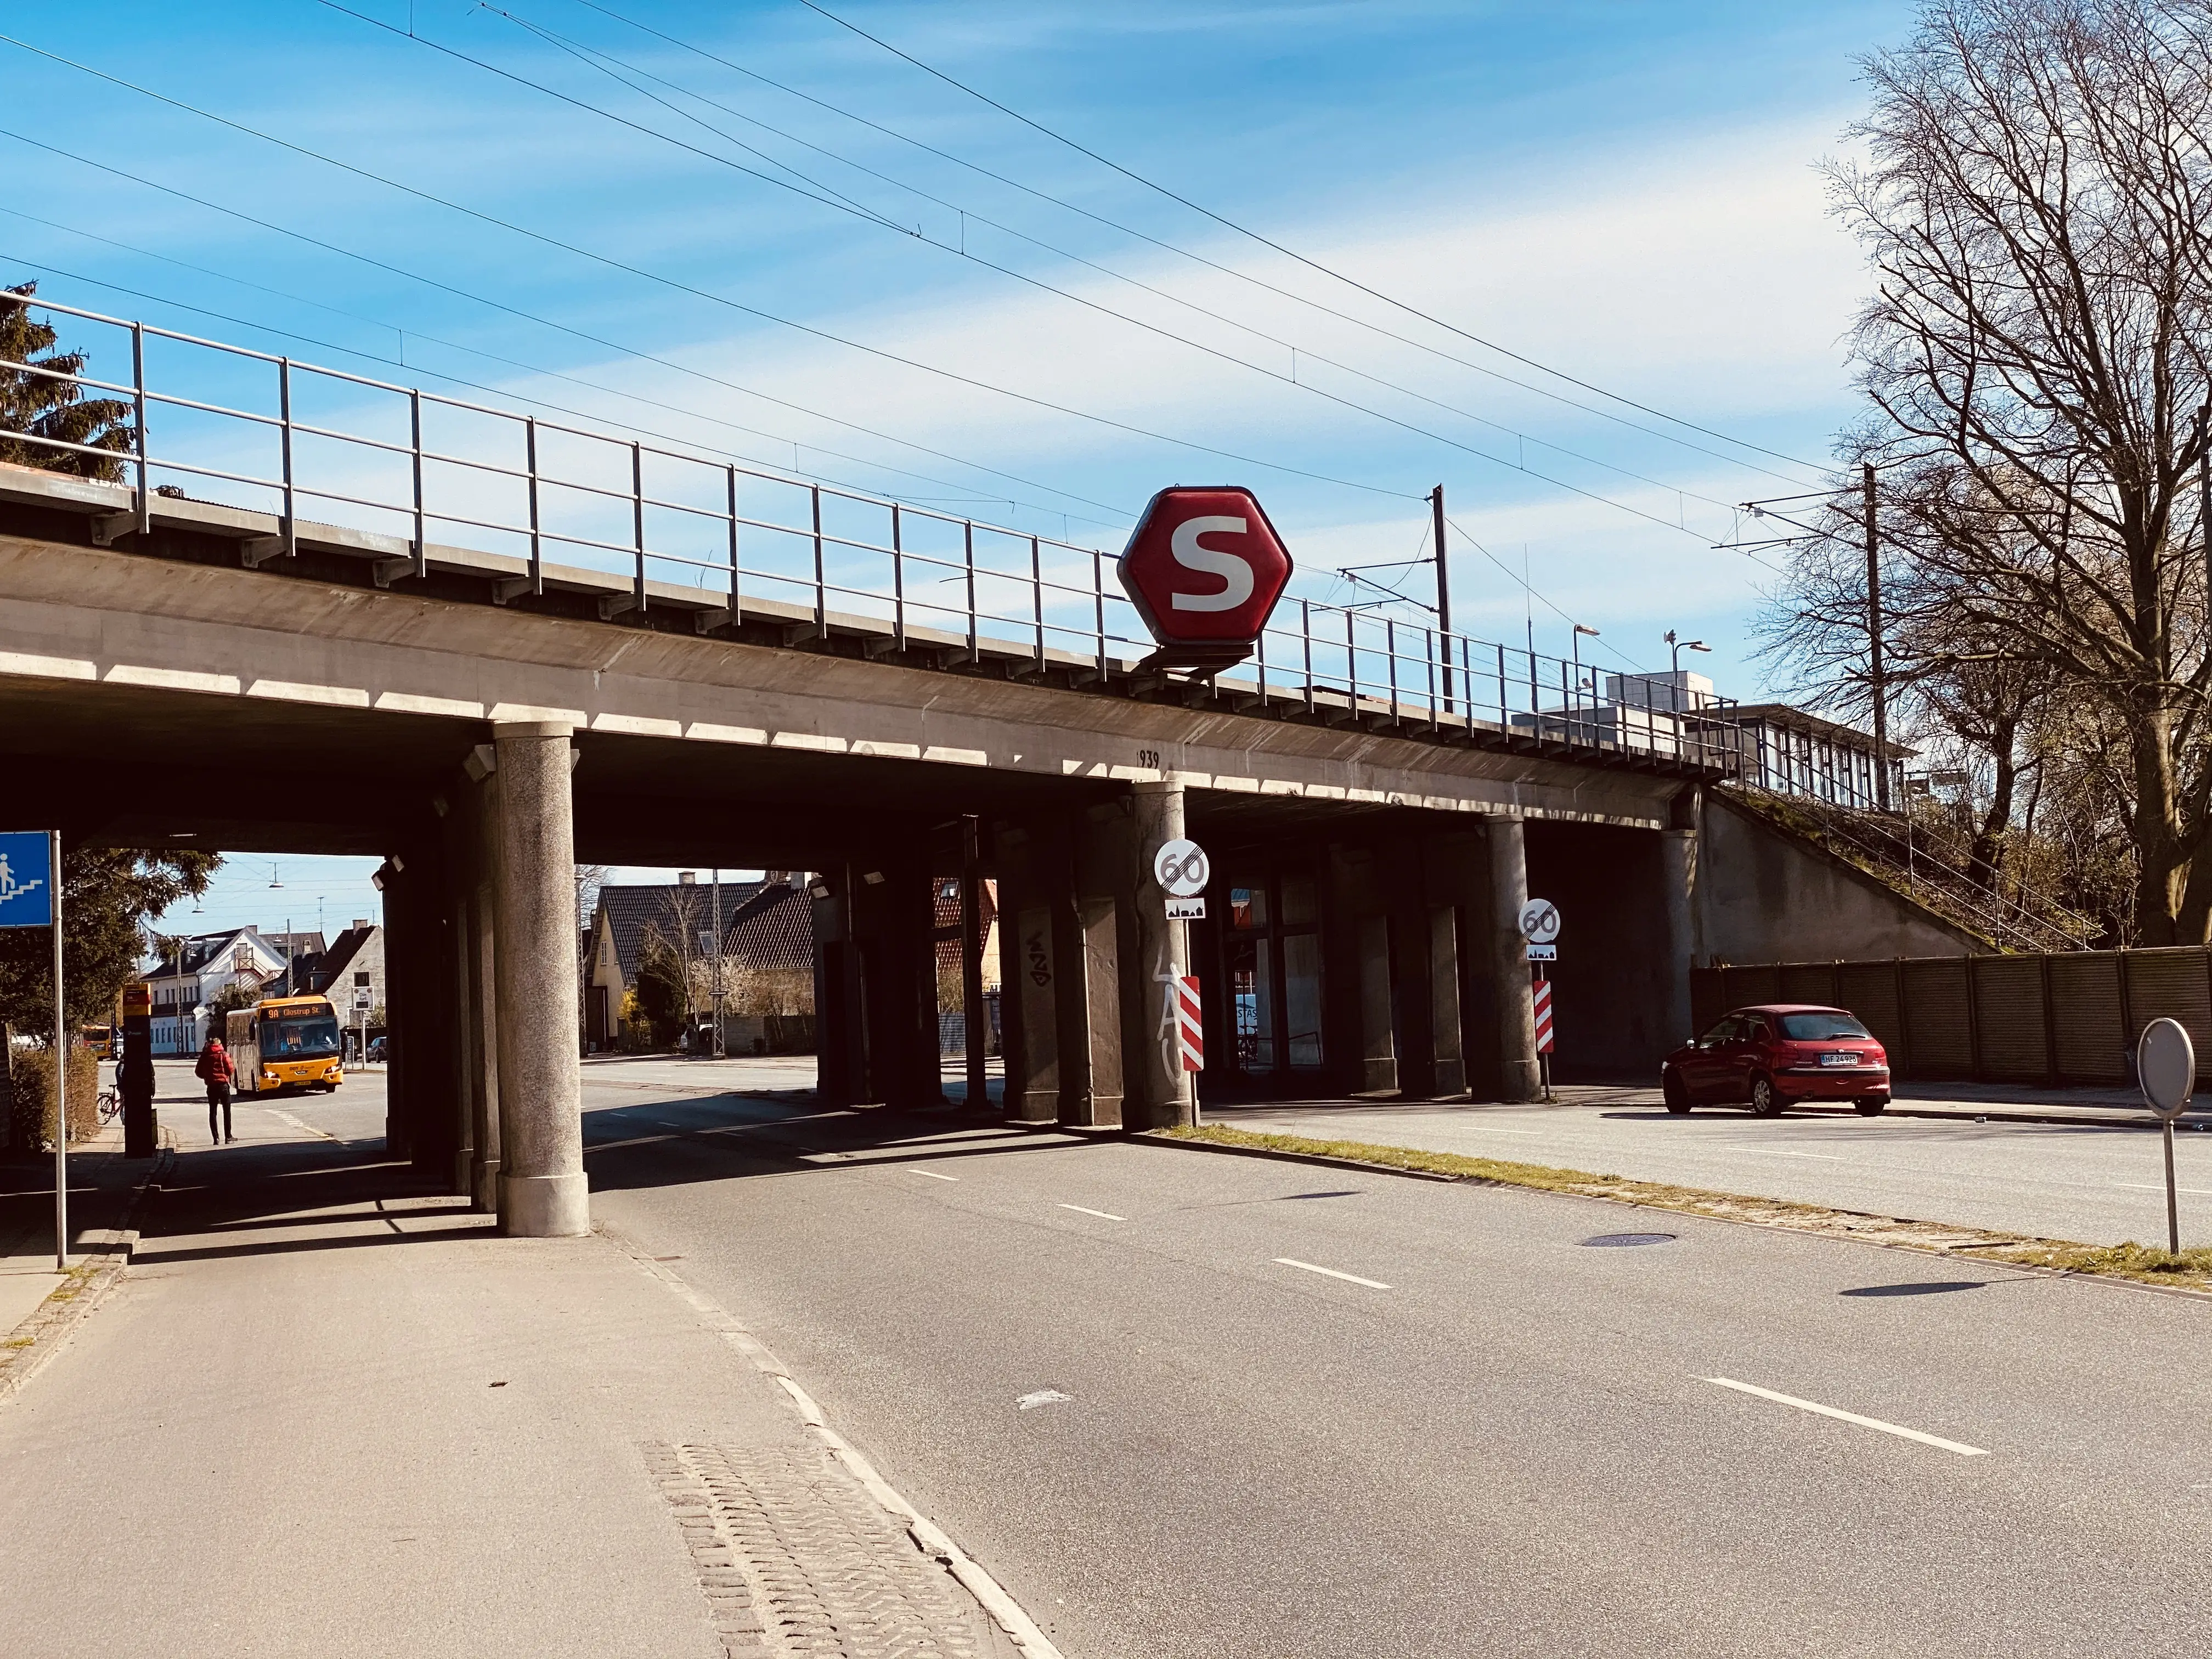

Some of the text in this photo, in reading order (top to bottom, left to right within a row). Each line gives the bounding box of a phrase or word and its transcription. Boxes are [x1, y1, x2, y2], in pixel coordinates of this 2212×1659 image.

[1171, 516, 1255, 612] S
[1160, 854, 1204, 884] 60
[1523, 910, 1556, 934] 60
[268, 1009, 279, 1018] 9A
